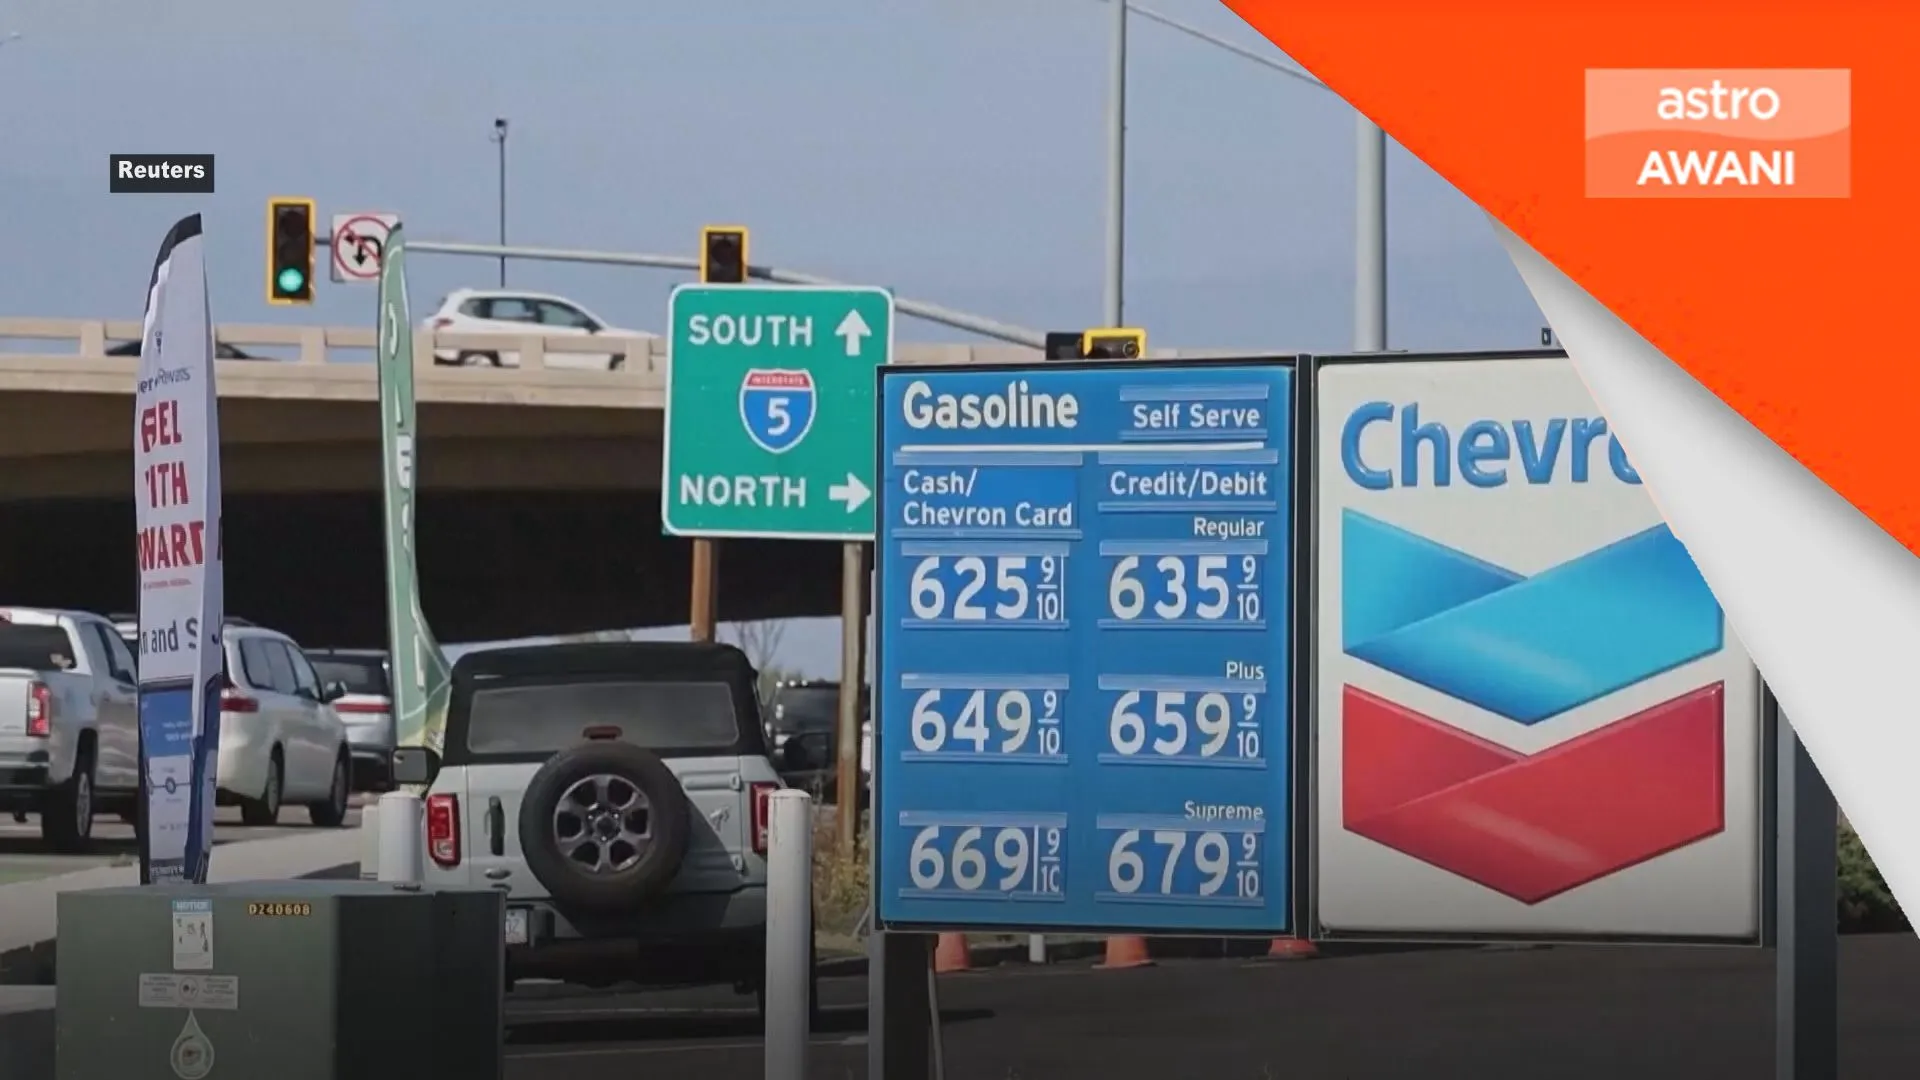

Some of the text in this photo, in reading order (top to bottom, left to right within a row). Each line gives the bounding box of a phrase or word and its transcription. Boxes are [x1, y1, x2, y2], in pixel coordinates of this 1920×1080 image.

[688, 314, 813, 347] SOUTH
[767, 397, 791, 436] 5
[903, 380, 1079, 430] Gasoline
[1133, 403, 1260, 429] Self Serve
[680, 473, 806, 507] NORTH
[903, 468, 978, 496] Cash/
[1110, 469, 1267, 496] Credit/Debit
[903, 501, 1073, 527] Chevron Card
[1194, 517, 1265, 540] Regular
[910, 555, 1029, 620] 625
[1110, 555, 1230, 620] 635
[151, 619, 179, 653] and
[1226, 661, 1264, 680] Plus
[911, 689, 1031, 753] 649
[1110, 690, 1231, 756] 659
[1185, 801, 1263, 822] Supreme
[910, 825, 1028, 891] 669
[1109, 829, 1230, 895] 679
